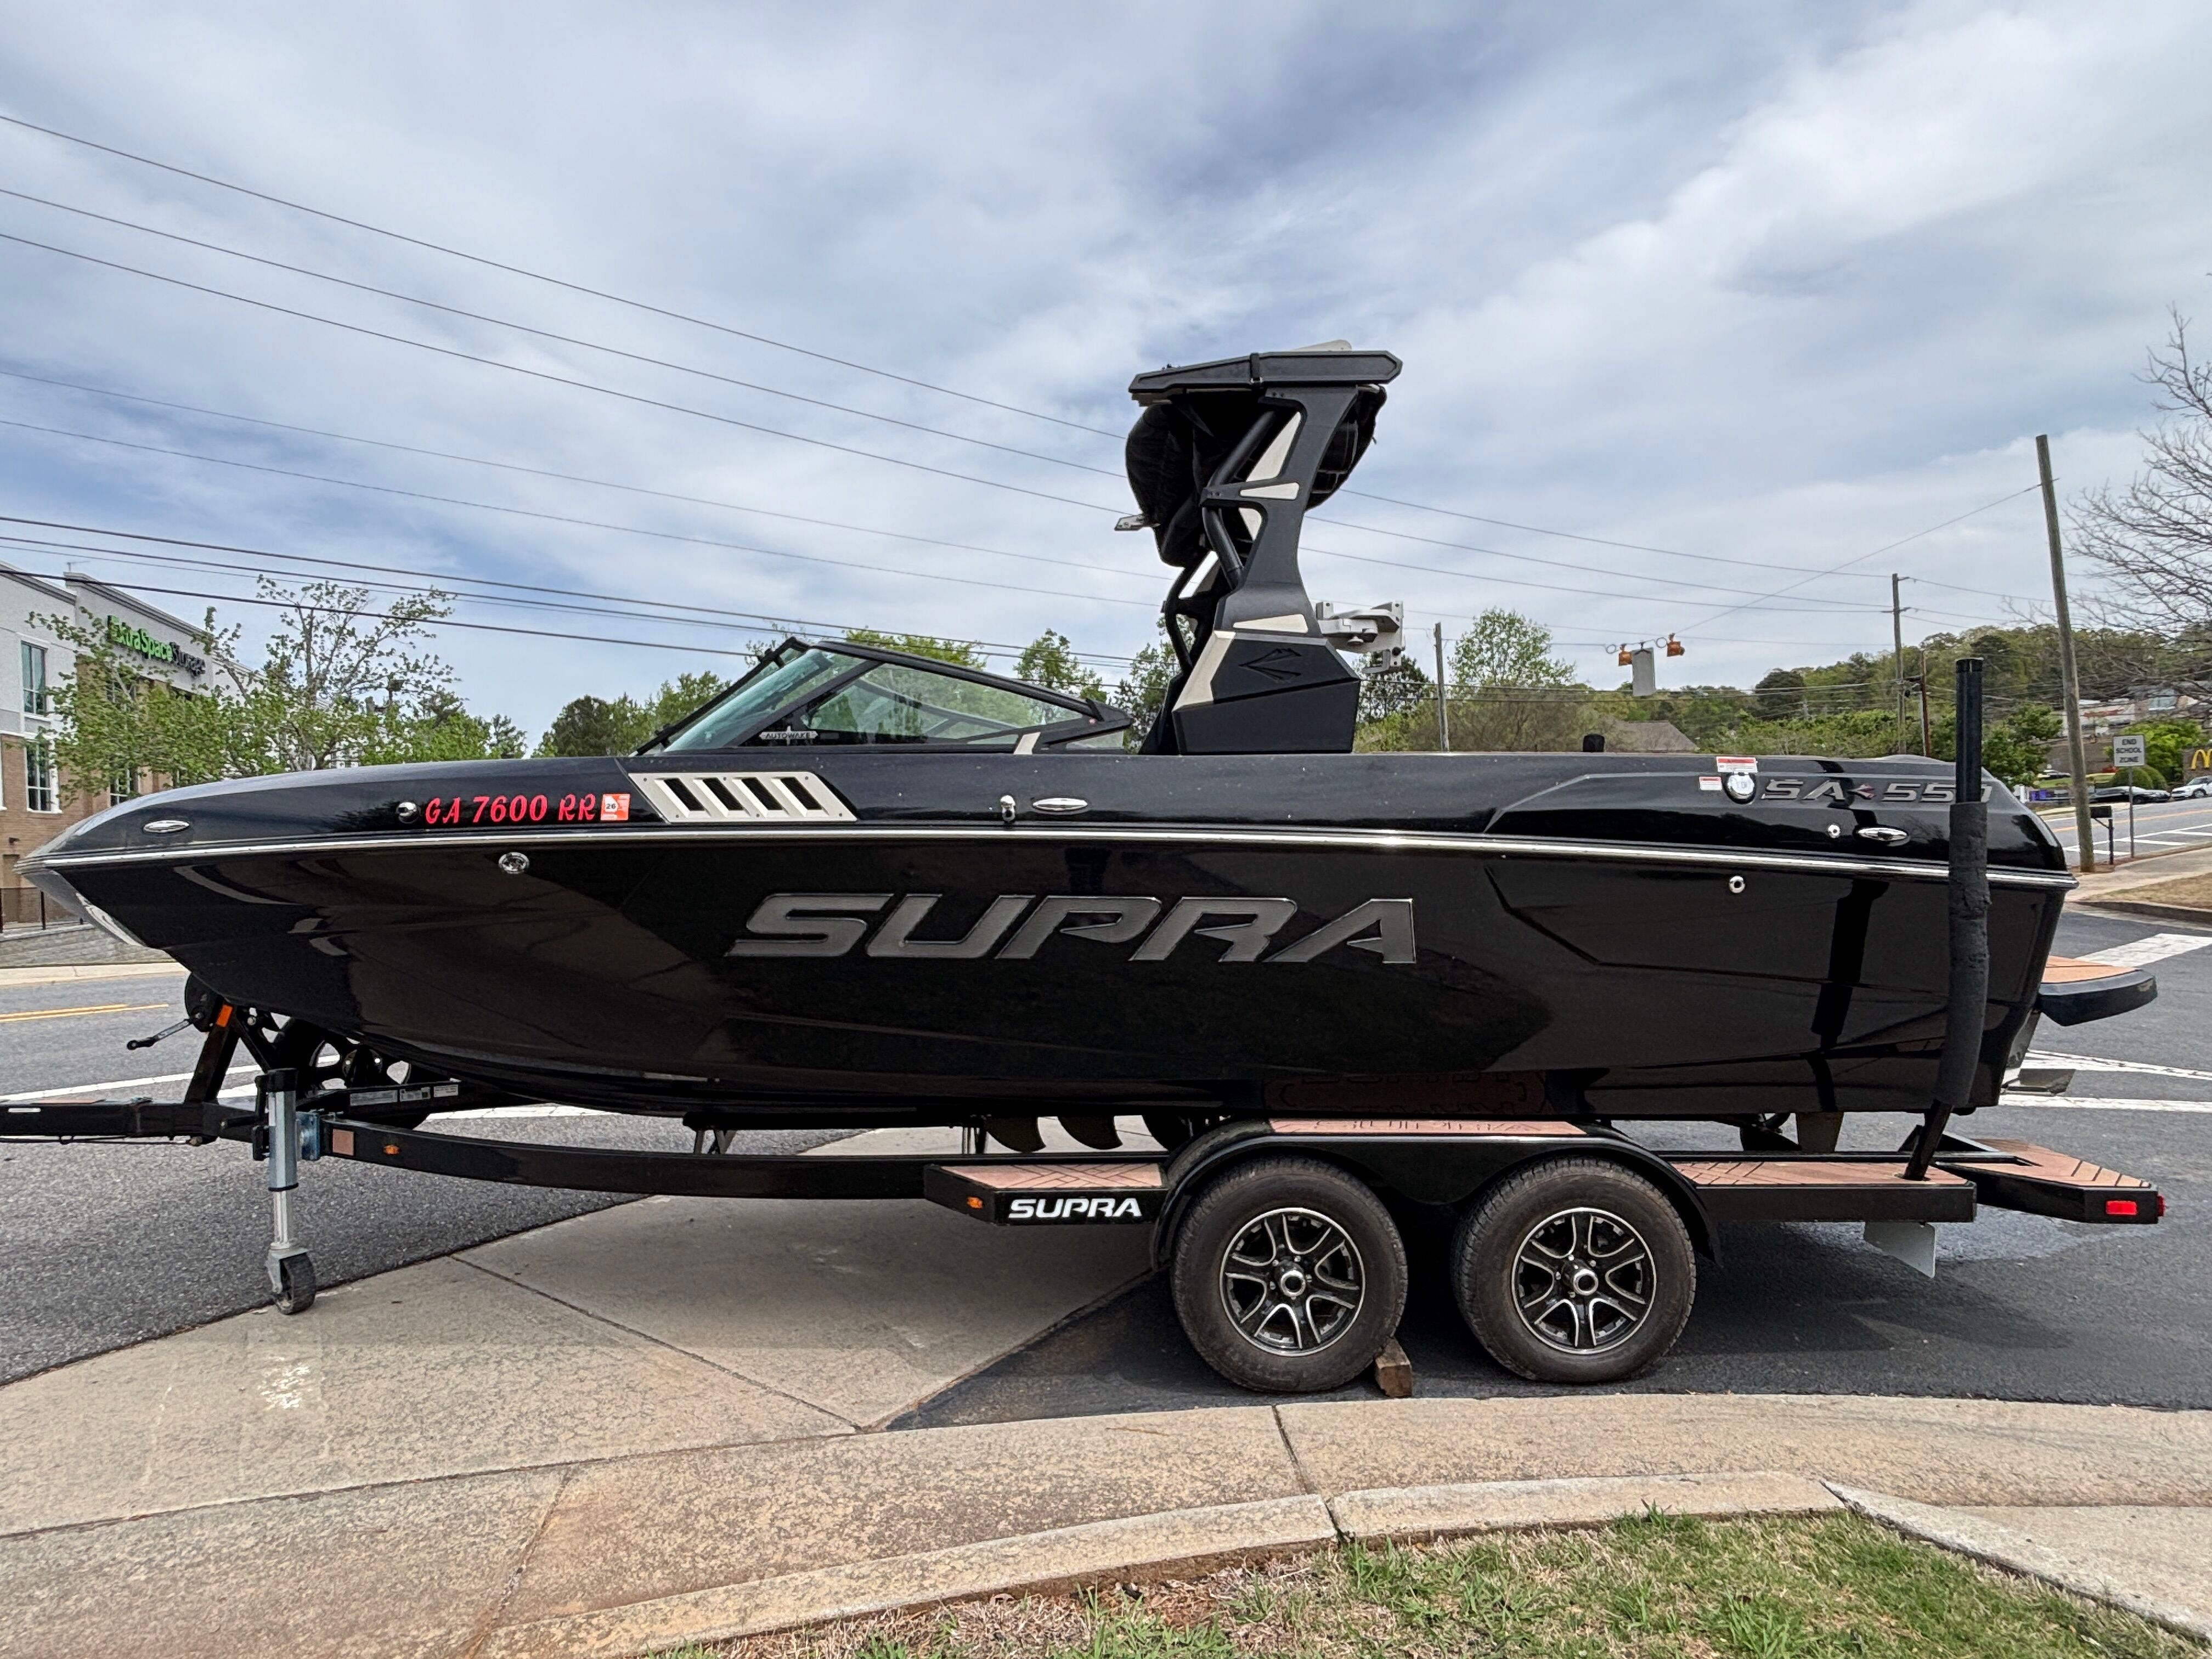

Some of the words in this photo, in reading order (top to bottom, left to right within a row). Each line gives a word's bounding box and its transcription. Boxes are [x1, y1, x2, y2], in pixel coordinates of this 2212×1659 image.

[1761, 779, 1846, 801] SA
[425, 797, 461, 823] GA
[472, 794, 548, 823] 7600
[558, 793, 597, 821] RR
[724, 893, 1417, 963] SUPRA
[1008, 1198, 1142, 1219] SUPRA
